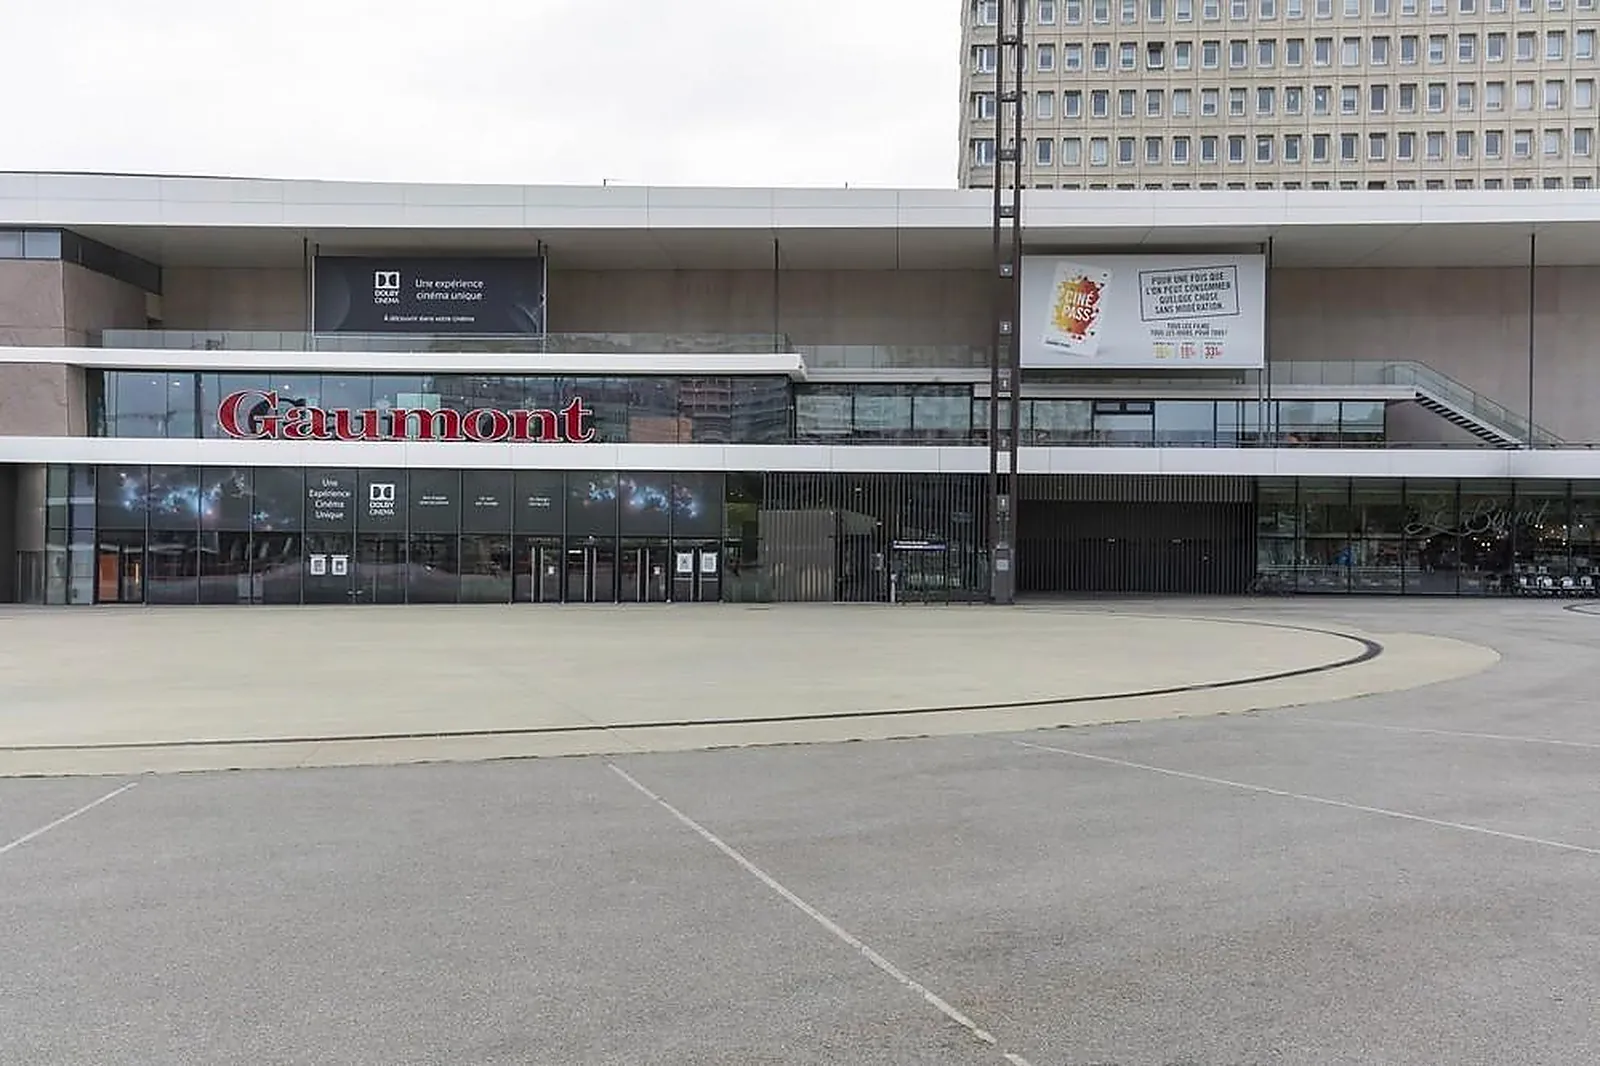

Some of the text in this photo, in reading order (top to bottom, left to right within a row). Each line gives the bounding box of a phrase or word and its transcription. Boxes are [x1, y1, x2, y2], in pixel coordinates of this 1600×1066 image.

[415, 279, 484, 290] Une expérience
[416, 291, 483, 301] cinéma unique
[218, 389, 596, 443] Gaumont
[322, 478, 339, 487] Une
